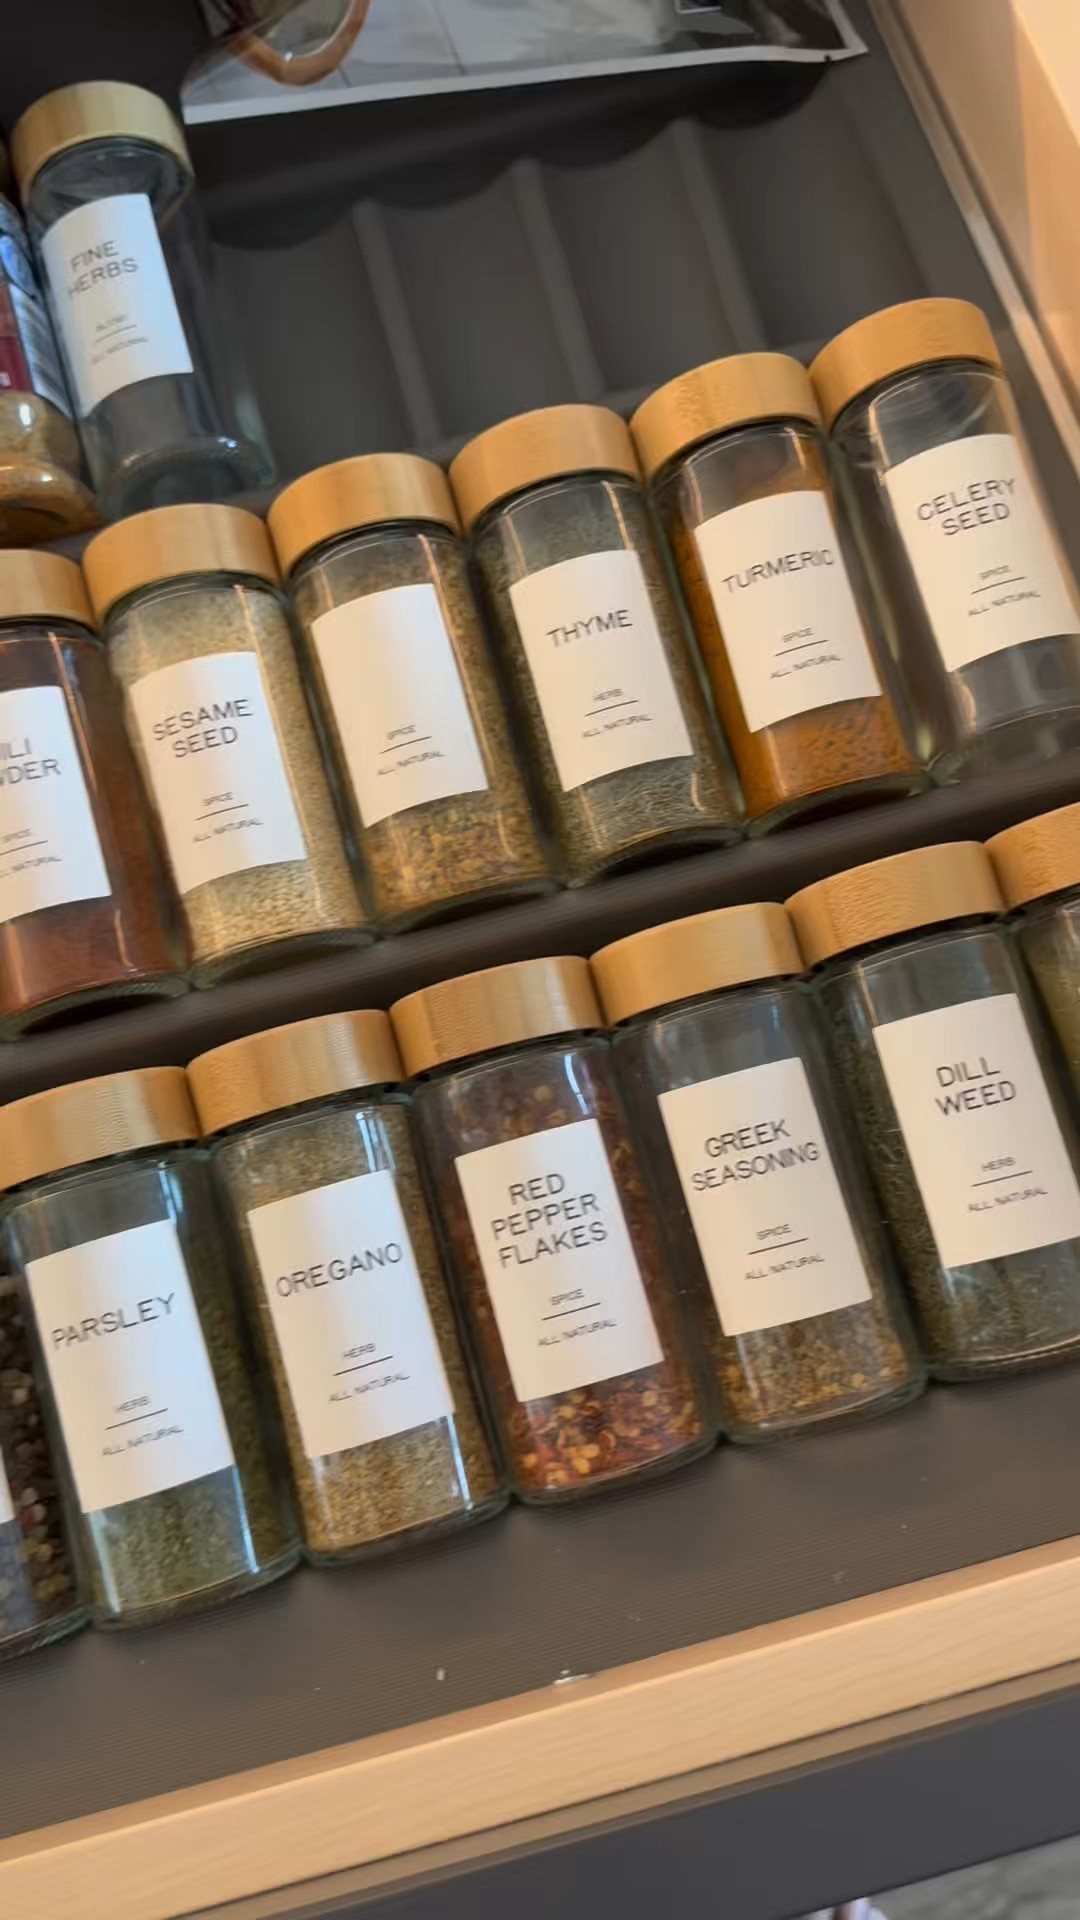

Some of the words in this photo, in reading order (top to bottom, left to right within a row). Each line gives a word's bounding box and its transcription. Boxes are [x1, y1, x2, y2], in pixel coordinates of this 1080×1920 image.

[70, 240, 119, 273] FINE
[67, 257, 138, 298] HERBS
[916, 478, 1015, 521] CELERY
[941, 502, 1010, 536] SEED
[722, 549, 834, 593] TURMERIC
[979, 565, 1010, 581] SPICE
[968, 607, 989, 617] ALL
[991, 590, 1041, 607] NATURAL
[547, 609, 633, 648] THYME
[782, 627, 814, 643] SPICE
[770, 668, 791, 680] ALL
[793, 654, 842, 671] NATURAL
[152, 698, 254, 742] SESAME
[604, 714, 653, 731] NATURAL
[171, 725, 239, 758] SEED
[0, 758, 62, 787] DER
[397, 751, 446, 767] NATURAL
[202, 791, 234, 807] SPICE
[214, 818, 265, 835] NATURAL
[935, 1056, 1001, 1088] DILL
[934, 1080, 1017, 1116] WEED
[704, 1118, 792, 1158] GREEK
[691, 1141, 822, 1193] SEASONING
[981, 1156, 1017, 1172] HERB
[509, 1172, 566, 1206] RED
[968, 1201, 993, 1213] ALL
[995, 1187, 1049, 1206] NATURAL
[490, 1193, 601, 1241] PEPPER
[756, 1222, 793, 1241] SPICE
[497, 1221, 609, 1269] FLAKES
[275, 1241, 403, 1298] OREGANO
[744, 1266, 768, 1282] ALL
[769, 1253, 824, 1275] NATURAL
[549, 1288, 585, 1306] SPICE
[50, 1292, 176, 1350] PARSLEY
[538, 1331, 562, 1347] ALL
[562, 1317, 617, 1340] NATURAL
[342, 1342, 376, 1360] HERB
[329, 1388, 353, 1402] ALL
[354, 1374, 411, 1394] NATURAL
[114, 1395, 150, 1413] HERB
[102, 1442, 126, 1457] ALL
[127, 1427, 185, 1449] NATURAL
